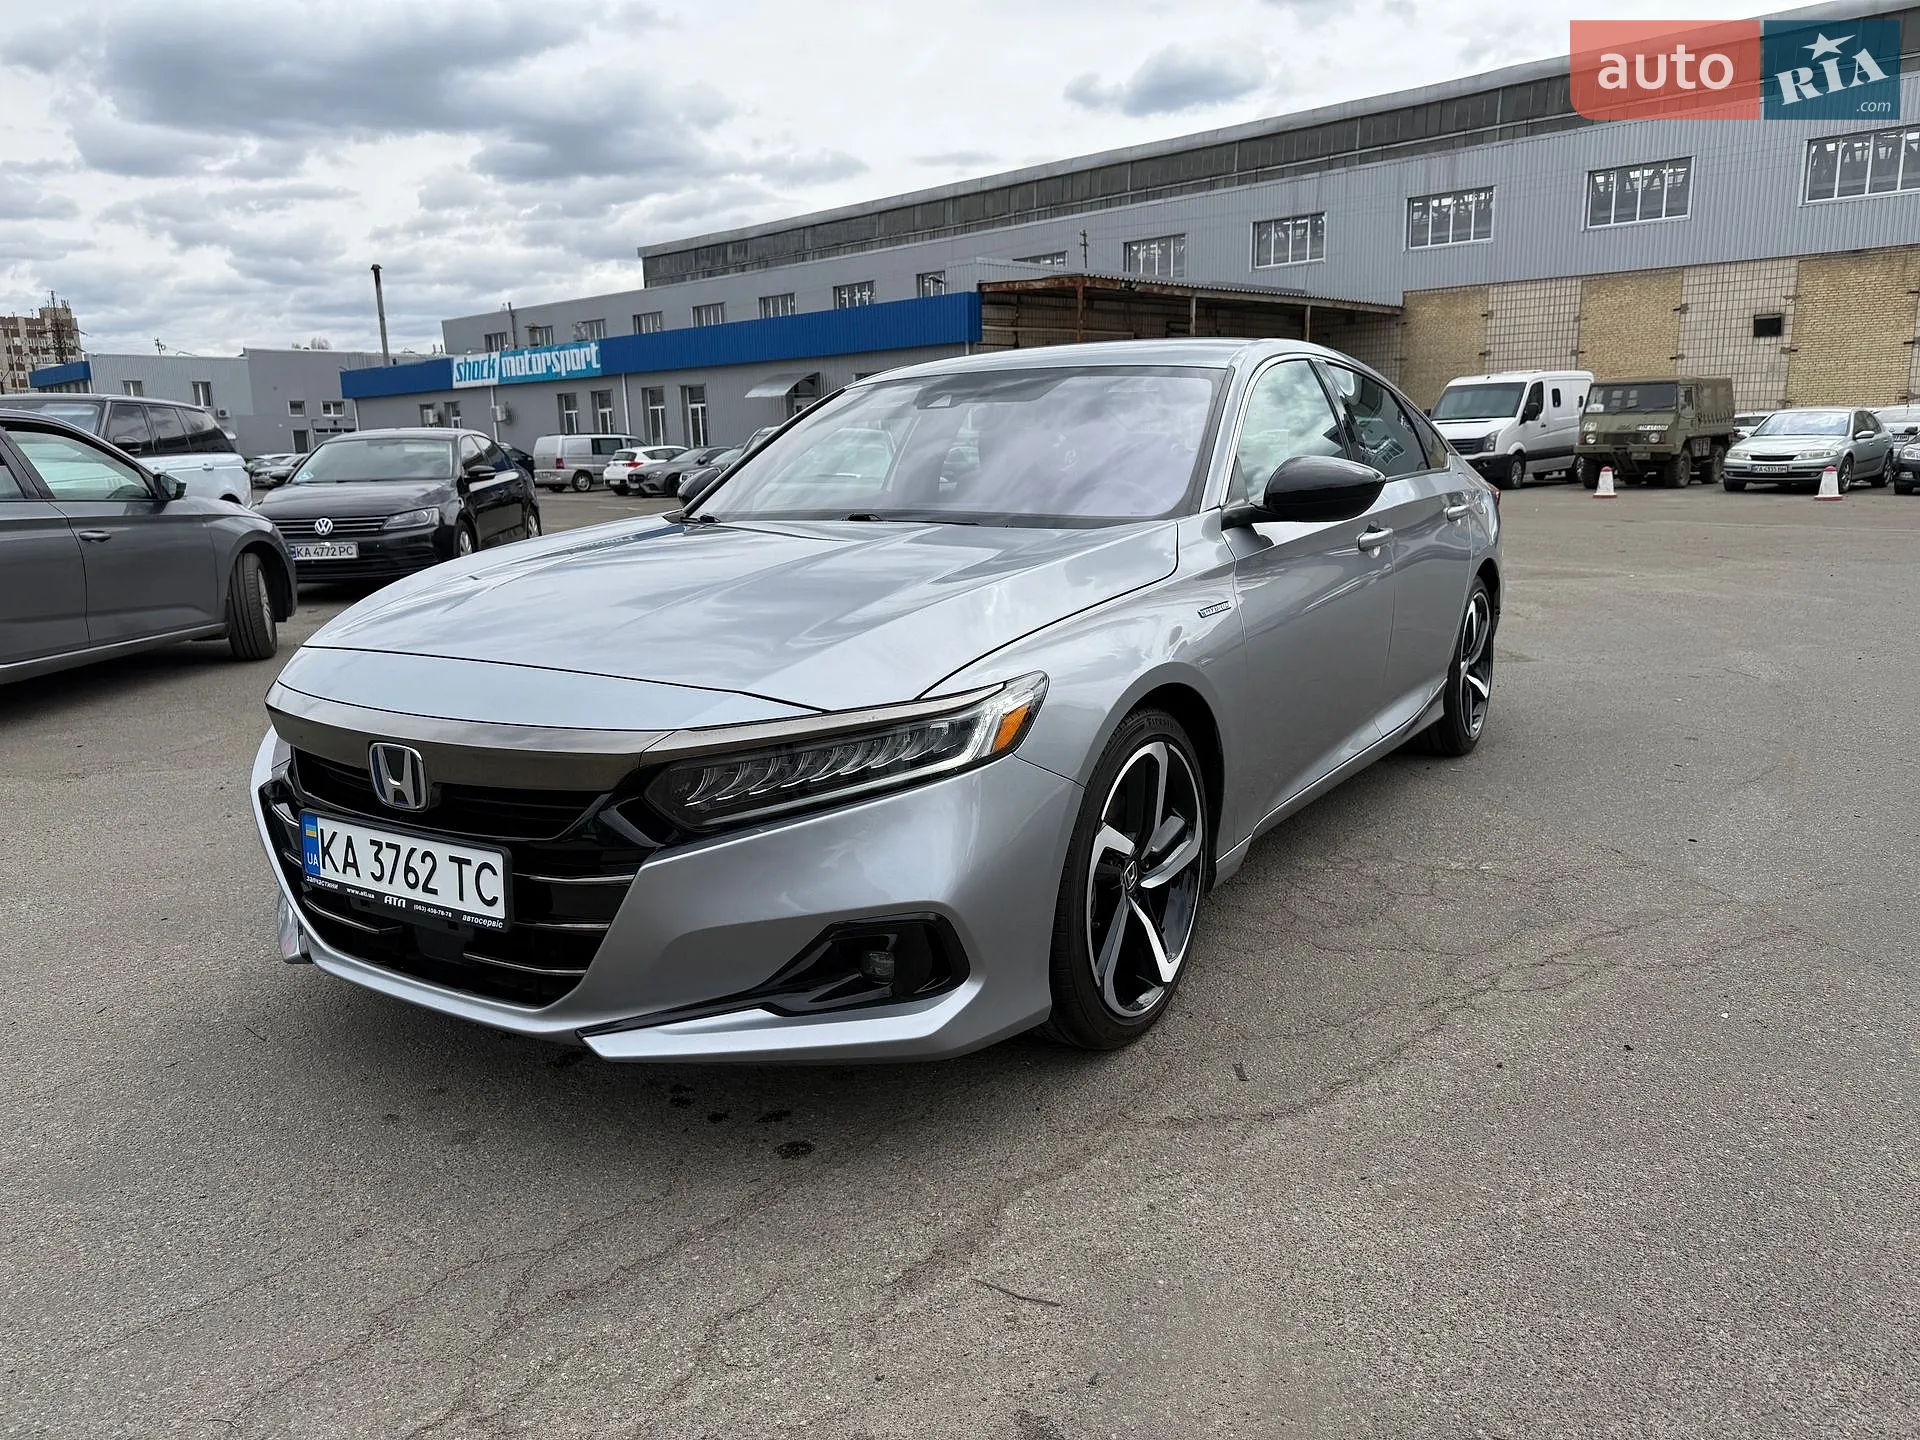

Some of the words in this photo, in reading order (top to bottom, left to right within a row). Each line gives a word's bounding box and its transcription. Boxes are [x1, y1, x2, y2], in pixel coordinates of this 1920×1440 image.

[455, 353, 497, 383] shock
[501, 342, 601, 378] motorsport
[296, 547, 311, 557] KA
[313, 546, 337, 557] 4772
[339, 546, 354, 556] PC
[307, 852, 319, 867] UA
[319, 828, 361, 878] KA
[369, 838, 438, 896] 3762
[448, 854, 499, 907] TC
[462, 914, 503, 929] автосервіс
